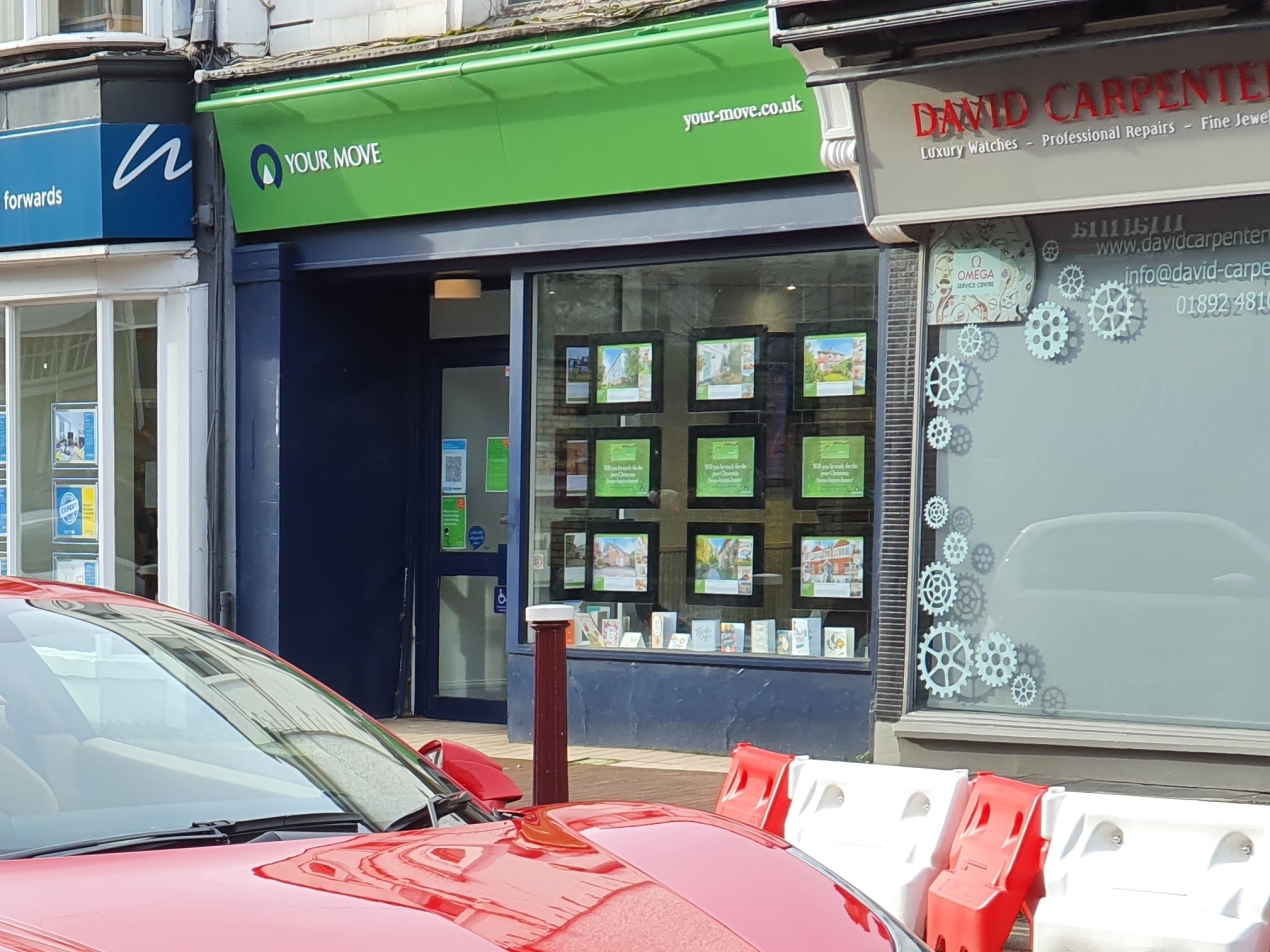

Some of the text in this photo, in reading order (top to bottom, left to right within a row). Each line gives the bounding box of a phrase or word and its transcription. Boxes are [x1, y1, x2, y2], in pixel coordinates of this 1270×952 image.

[683, 94, 803, 132] your-move.co.uk
[911, 61, 1270, 138] DAVID CARPENTE
[920, 146, 965, 160] Luxury
[968, 138, 1018, 154] Watches
[1042, 125, 1121, 147] Professional
[1125, 120, 1176, 139] Repairs
[1201, 114, 1231, 131] Fine
[284, 142, 382, 175] YOUR MOVE
[4, 185, 63, 210] forwards
[957, 269, 995, 281] OMEGA
[976, 281, 994, 289] CENTRE
[1176, 292, 1228, 315] 01892
